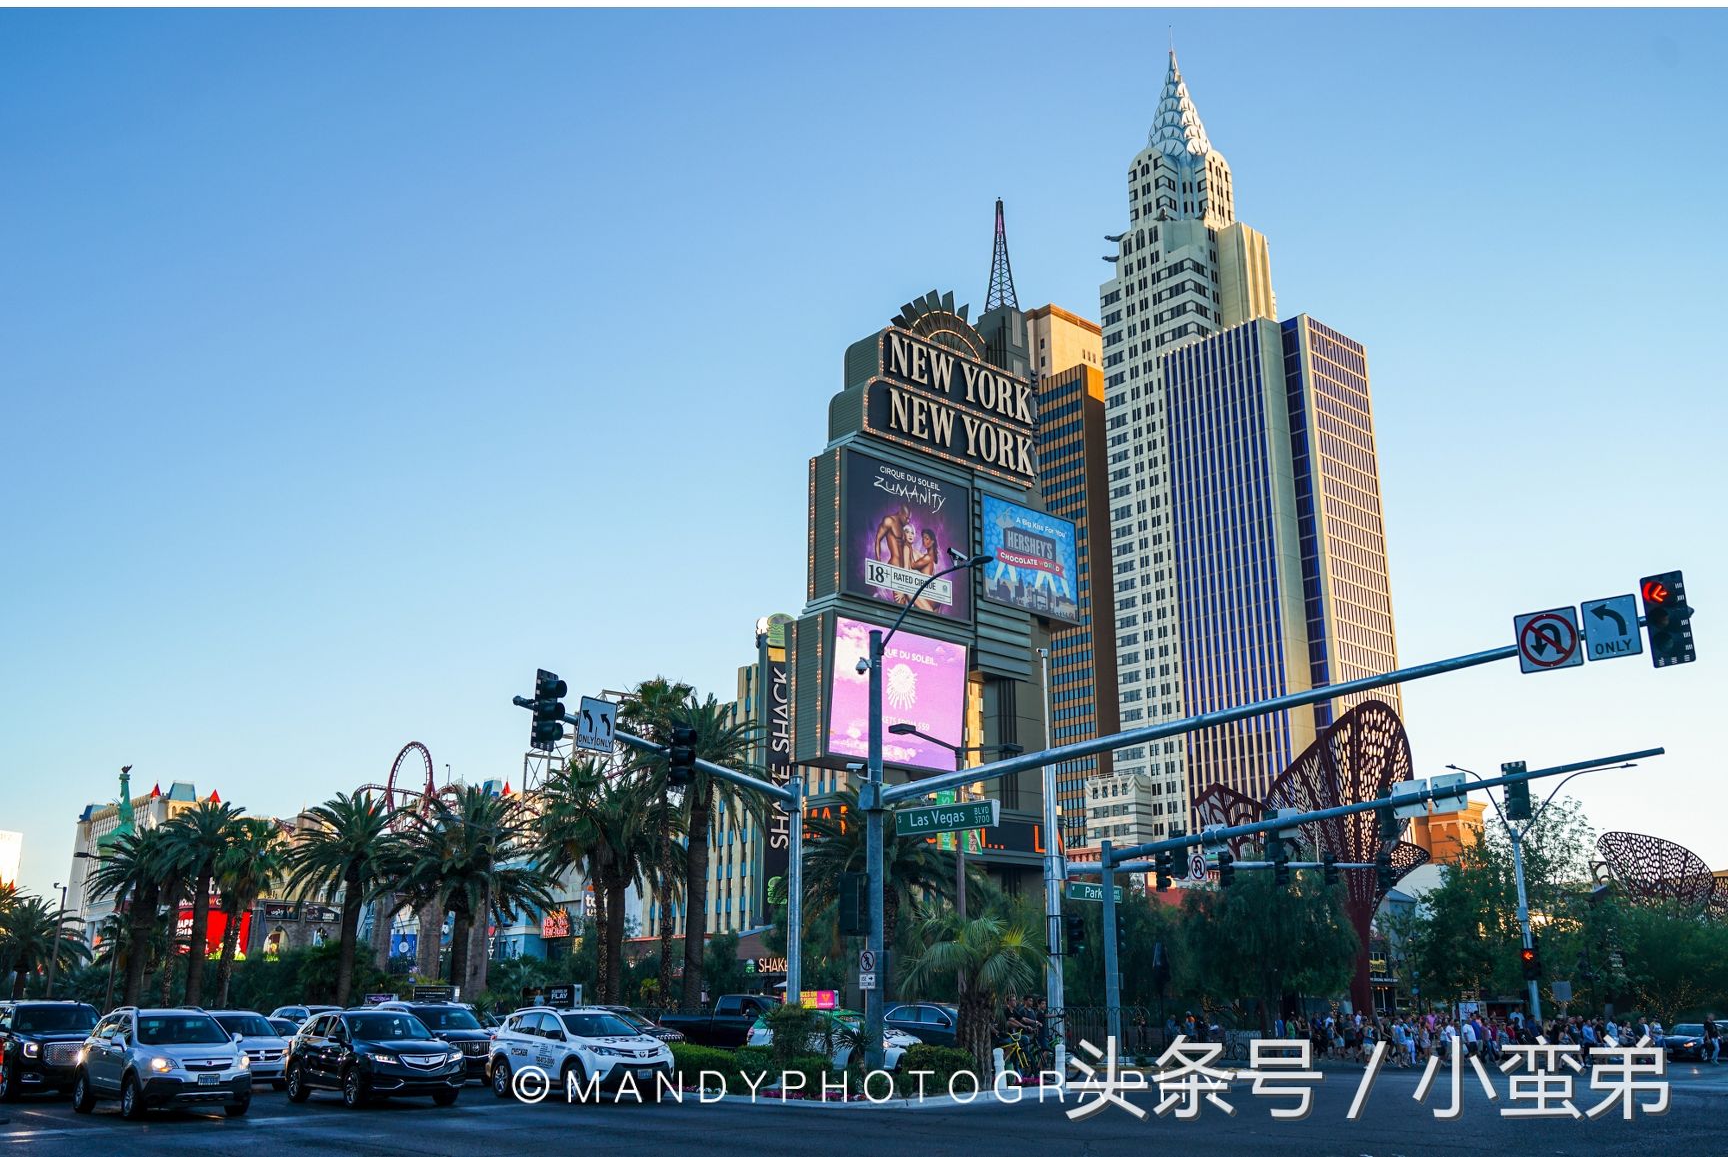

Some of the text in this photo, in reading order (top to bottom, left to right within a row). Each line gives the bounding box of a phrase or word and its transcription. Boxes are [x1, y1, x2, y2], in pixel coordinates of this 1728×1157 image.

[890, 333, 1033, 425] NEW YORK
[890, 388, 1035, 477] NEW YORK
[880, 465, 941, 491] CIRQUE DU SOLEIL
[1007, 530, 1053, 560] HERSHEY'S
[1000, 551, 1060, 572] CHOCOLATE WORLD
[867, 564, 891, 583] 18+
[893, 572, 937, 591] RATED CIRUE
[899, 648, 910, 659] DU
[1595, 639, 1633, 655] ONLY
[772, 667, 788, 753] SHACK
[578, 734, 612, 748] ONLY ONLY
[909, 812, 929, 827] Las
[931, 809, 965, 828] Vegas
[973, 806, 990, 816] BLVD
[974, 814, 990, 824] 3700
[1084, 886, 1103, 899] Park
